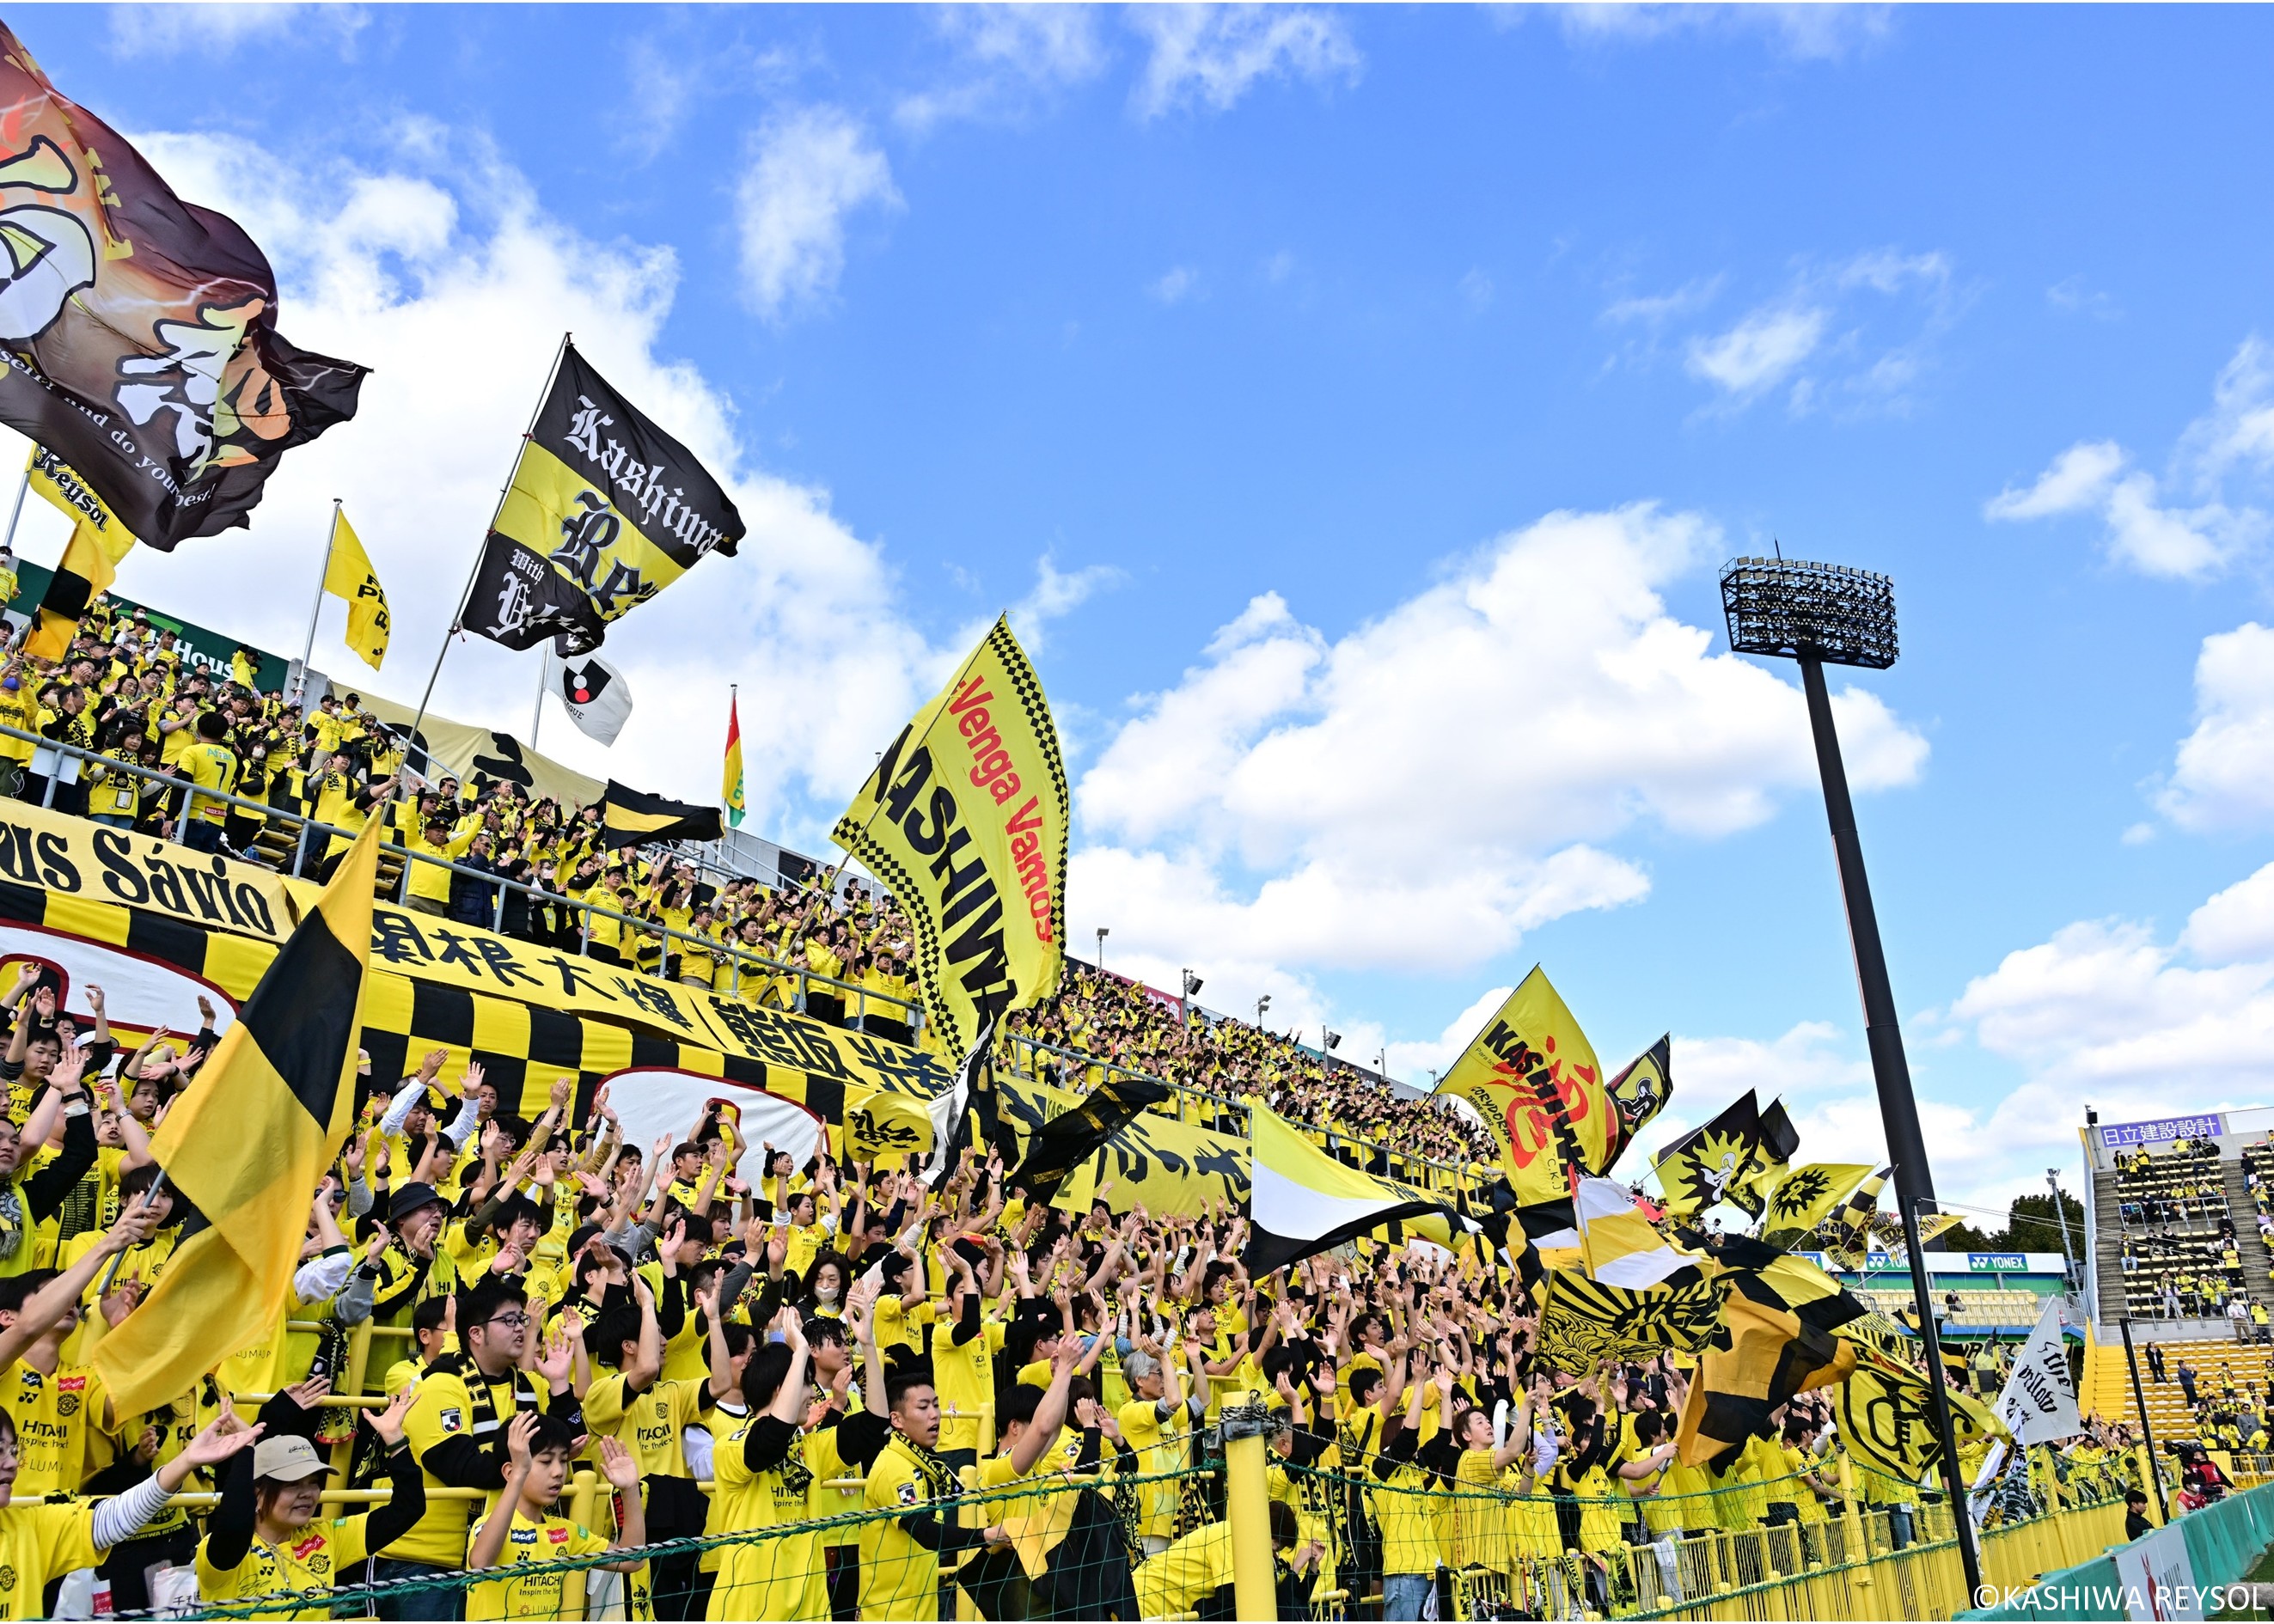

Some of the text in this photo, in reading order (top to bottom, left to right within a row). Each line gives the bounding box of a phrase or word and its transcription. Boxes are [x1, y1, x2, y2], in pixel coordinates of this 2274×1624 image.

[111, 430, 136, 454] do
[135, 455, 181, 496] your
[563, 394, 724, 557] Kashiwa
[510, 548, 545, 586] With
[216, 761, 228, 791] 7
[92, 827, 277, 937] Sávio
[1467, 1096, 1495, 1126] DESDE 2002
[2103, 1116, 2218, 1146] 日立建設設計
[1990, 1256, 2027, 1269] YONEX
[22, 1420, 68, 1438] HITAHI
[773, 1499, 793, 1509] spire
[519, 1588, 542, 1597] Inspire
[542, 1587, 552, 1597] the
